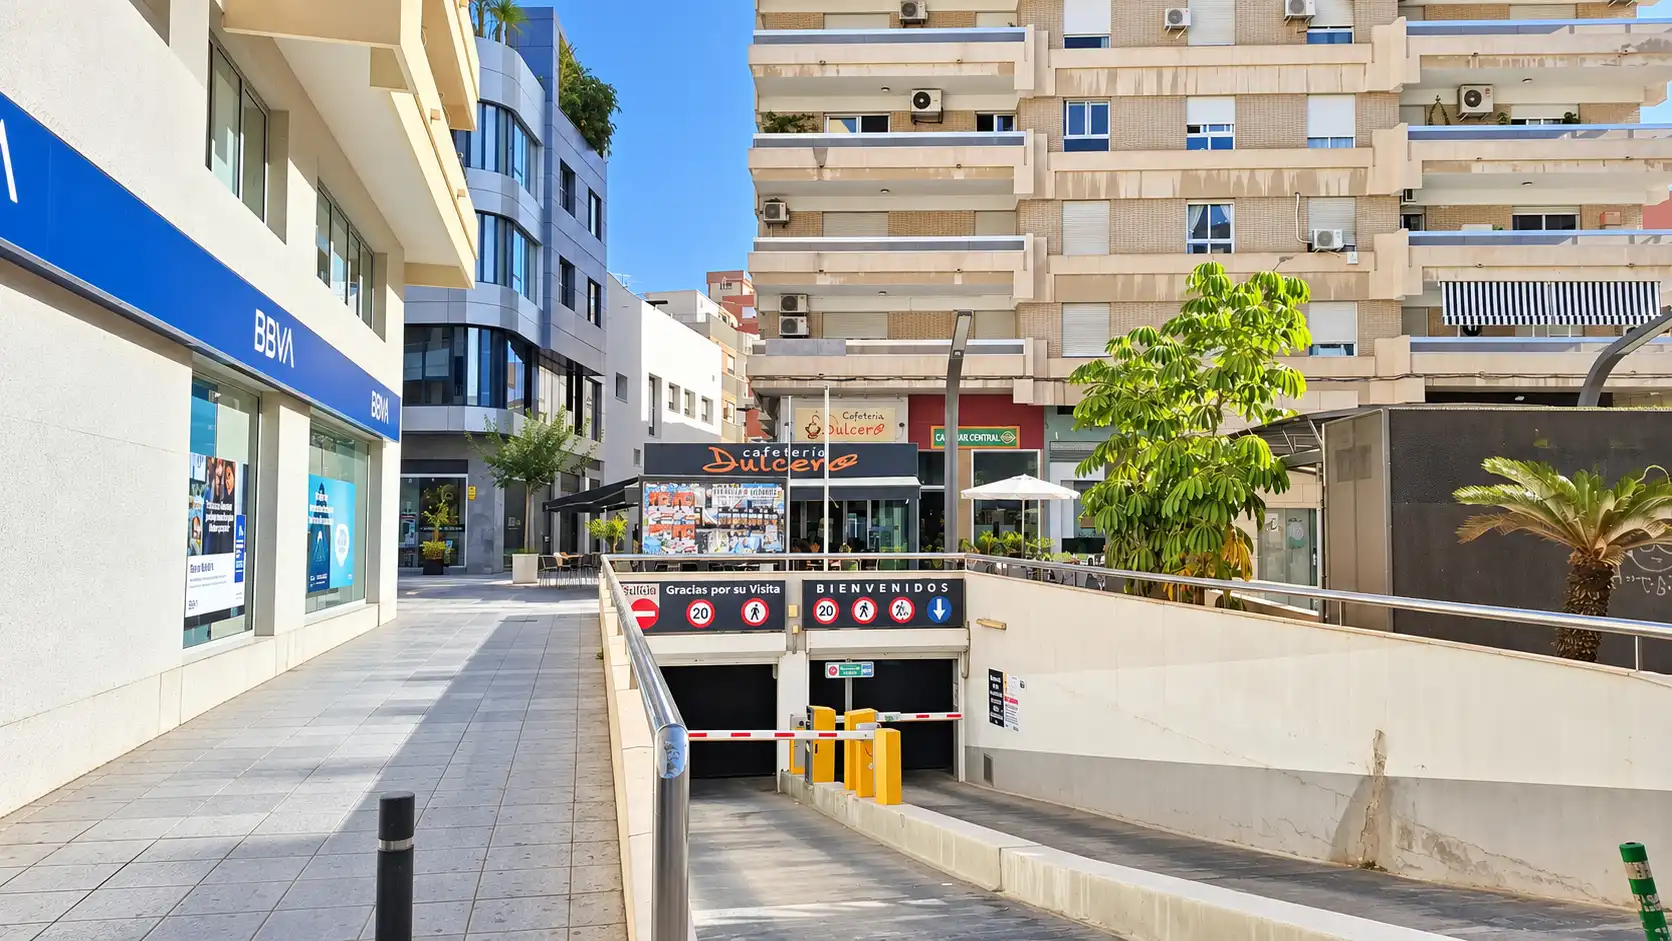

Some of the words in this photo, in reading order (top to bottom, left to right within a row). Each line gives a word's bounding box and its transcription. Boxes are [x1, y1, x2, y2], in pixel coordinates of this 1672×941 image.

[254, 308, 295, 369] BBVA
[371, 390, 389, 424] BBVA
[969, 433, 1001, 442] CENTRAL
[666, 584, 708, 595] Gracias
[711, 586, 731, 597] por
[733, 585, 747, 594] su
[749, 583, 781, 594] Visita
[816, 583, 949, 594] BIENVENIDOS
[692, 607, 709, 620] 20
[818, 605, 834, 617] 20
